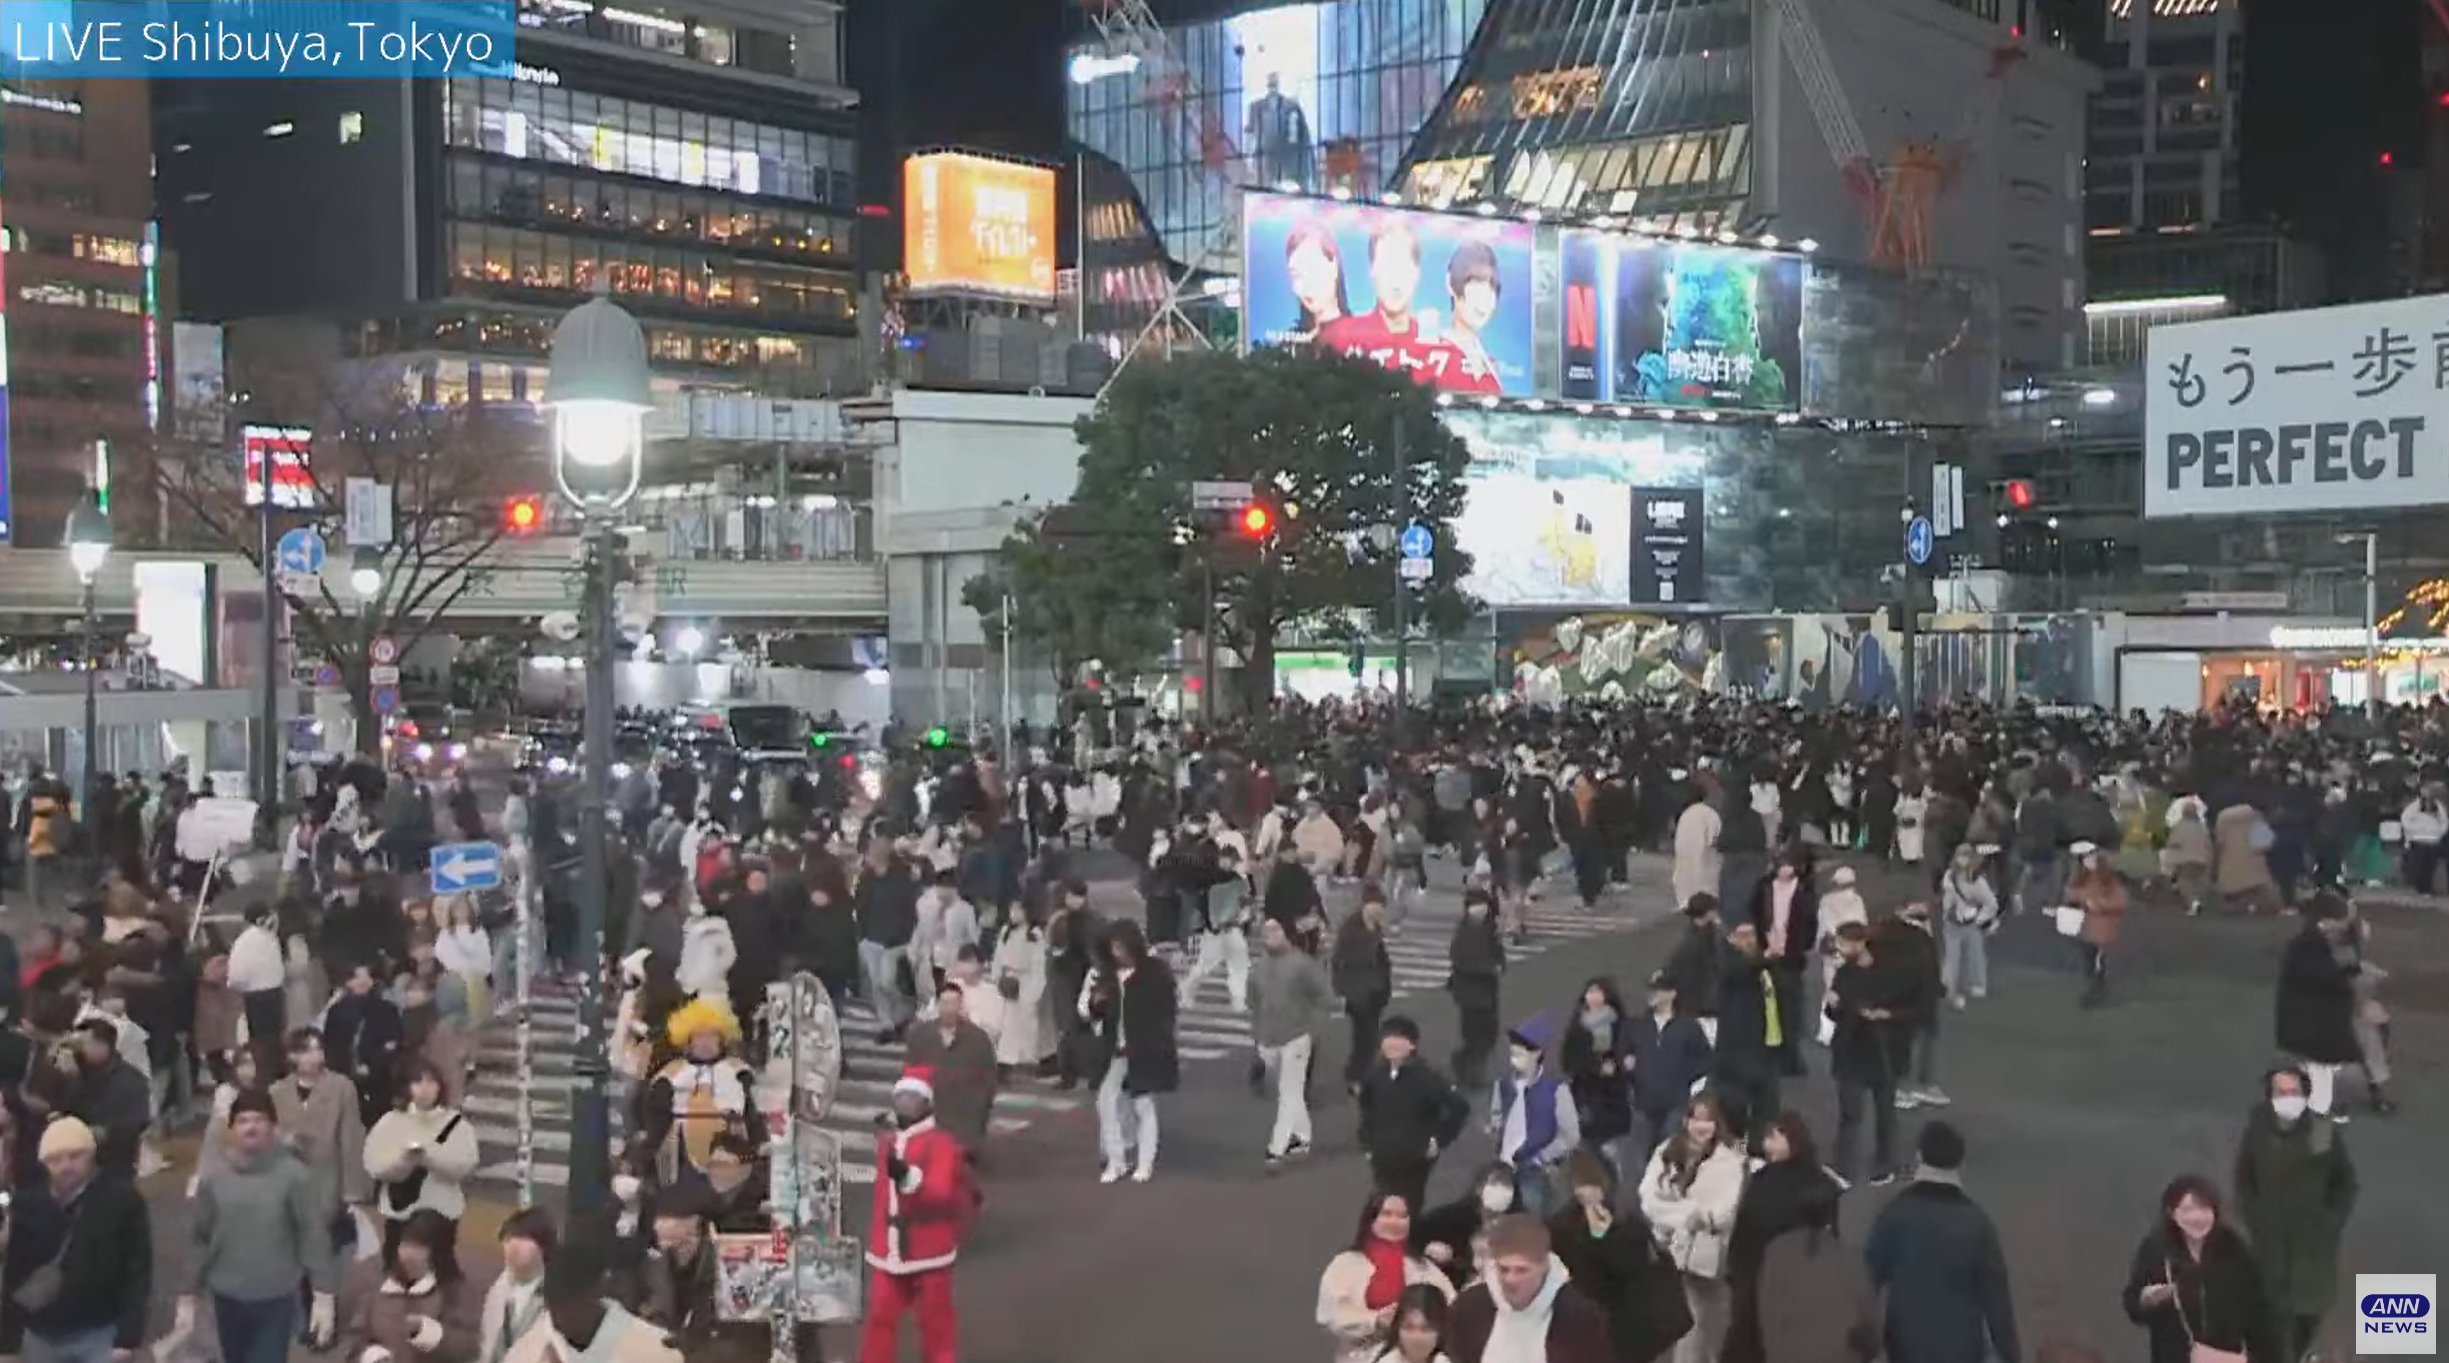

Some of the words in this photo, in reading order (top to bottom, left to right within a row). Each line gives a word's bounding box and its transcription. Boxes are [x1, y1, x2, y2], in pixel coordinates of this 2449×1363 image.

[1566, 282, 1596, 350] N
[2168, 320, 2449, 408] もう一歩
[2167, 415, 2425, 491] PERFECT
